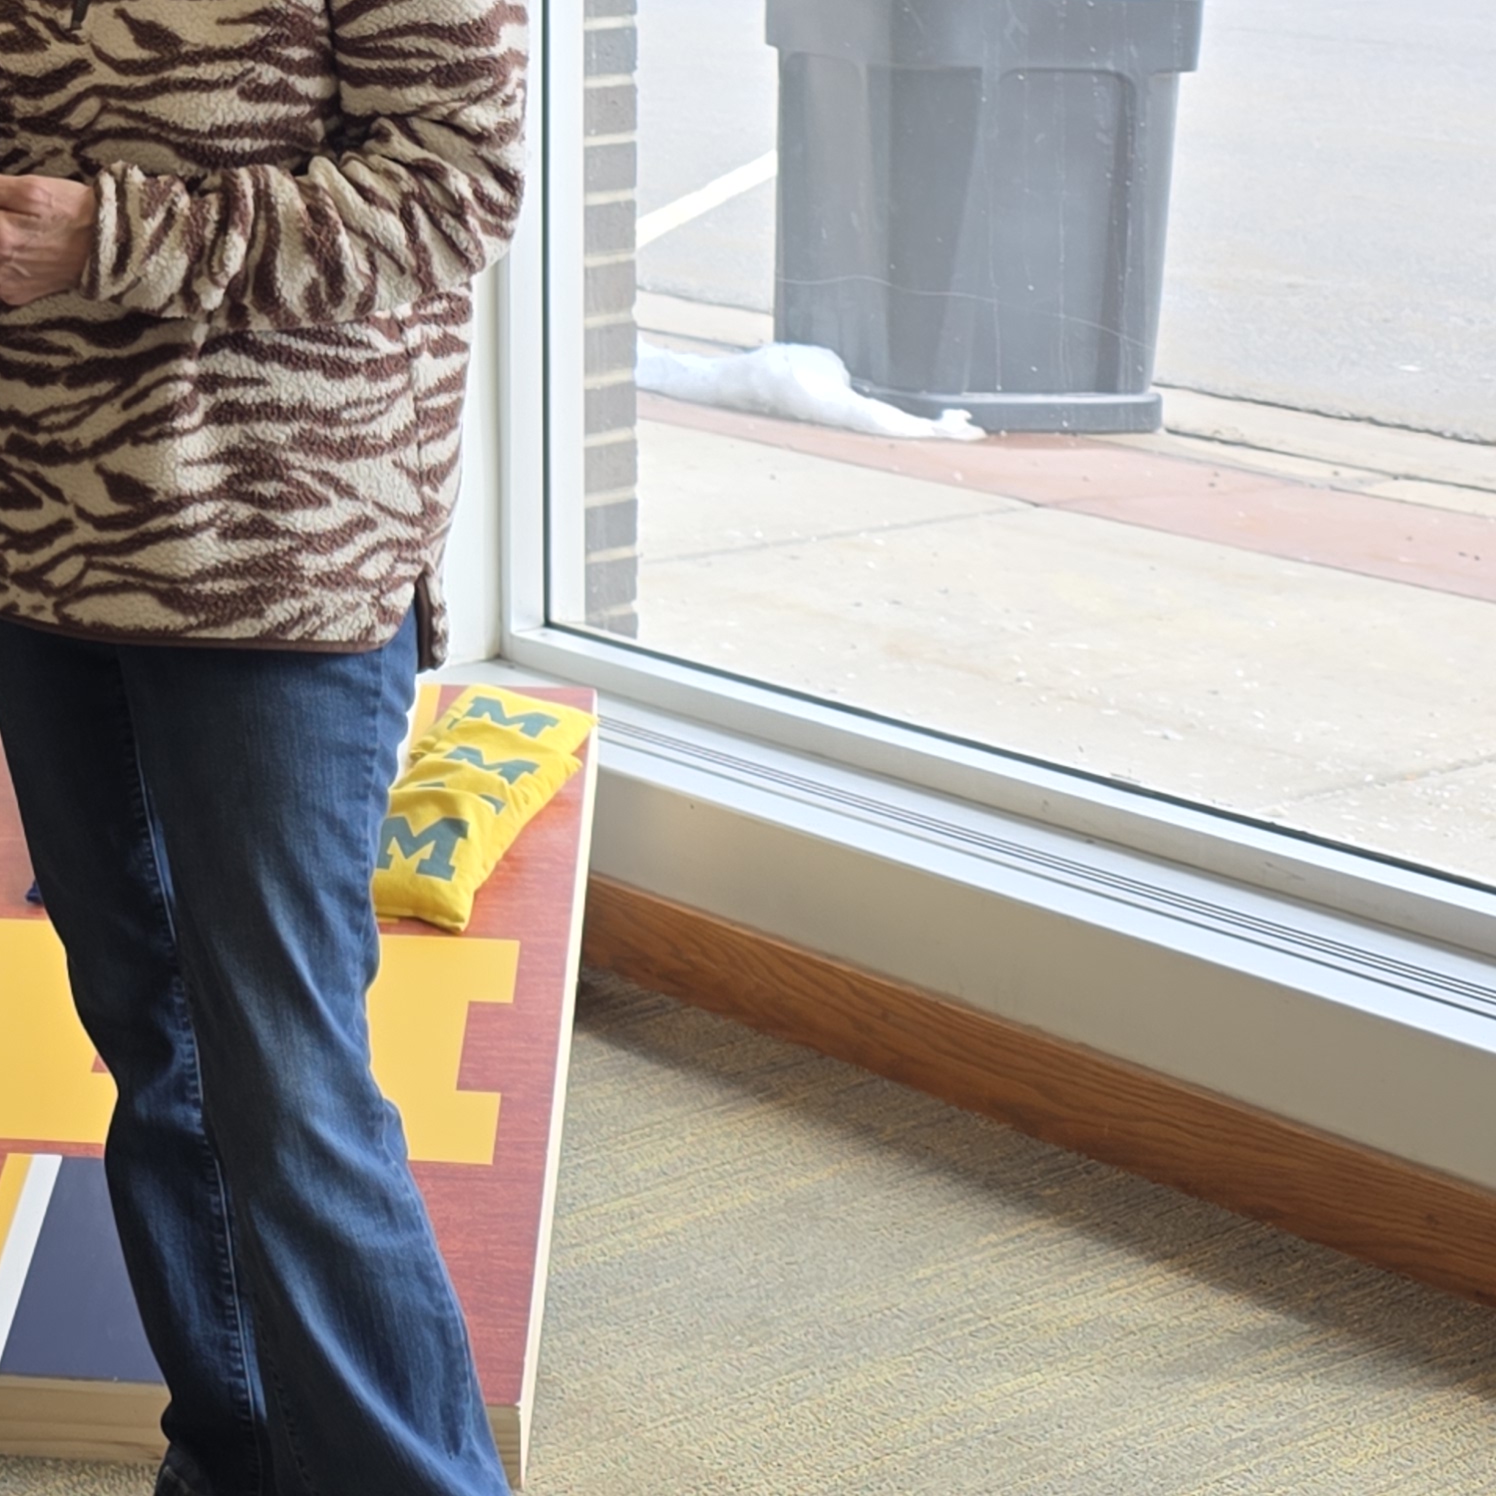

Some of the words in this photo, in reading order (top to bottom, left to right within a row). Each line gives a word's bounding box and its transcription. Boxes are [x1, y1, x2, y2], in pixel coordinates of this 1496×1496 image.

[447, 695, 560, 739] M
[443, 745, 541, 786] M
[377, 815, 470, 882] M
